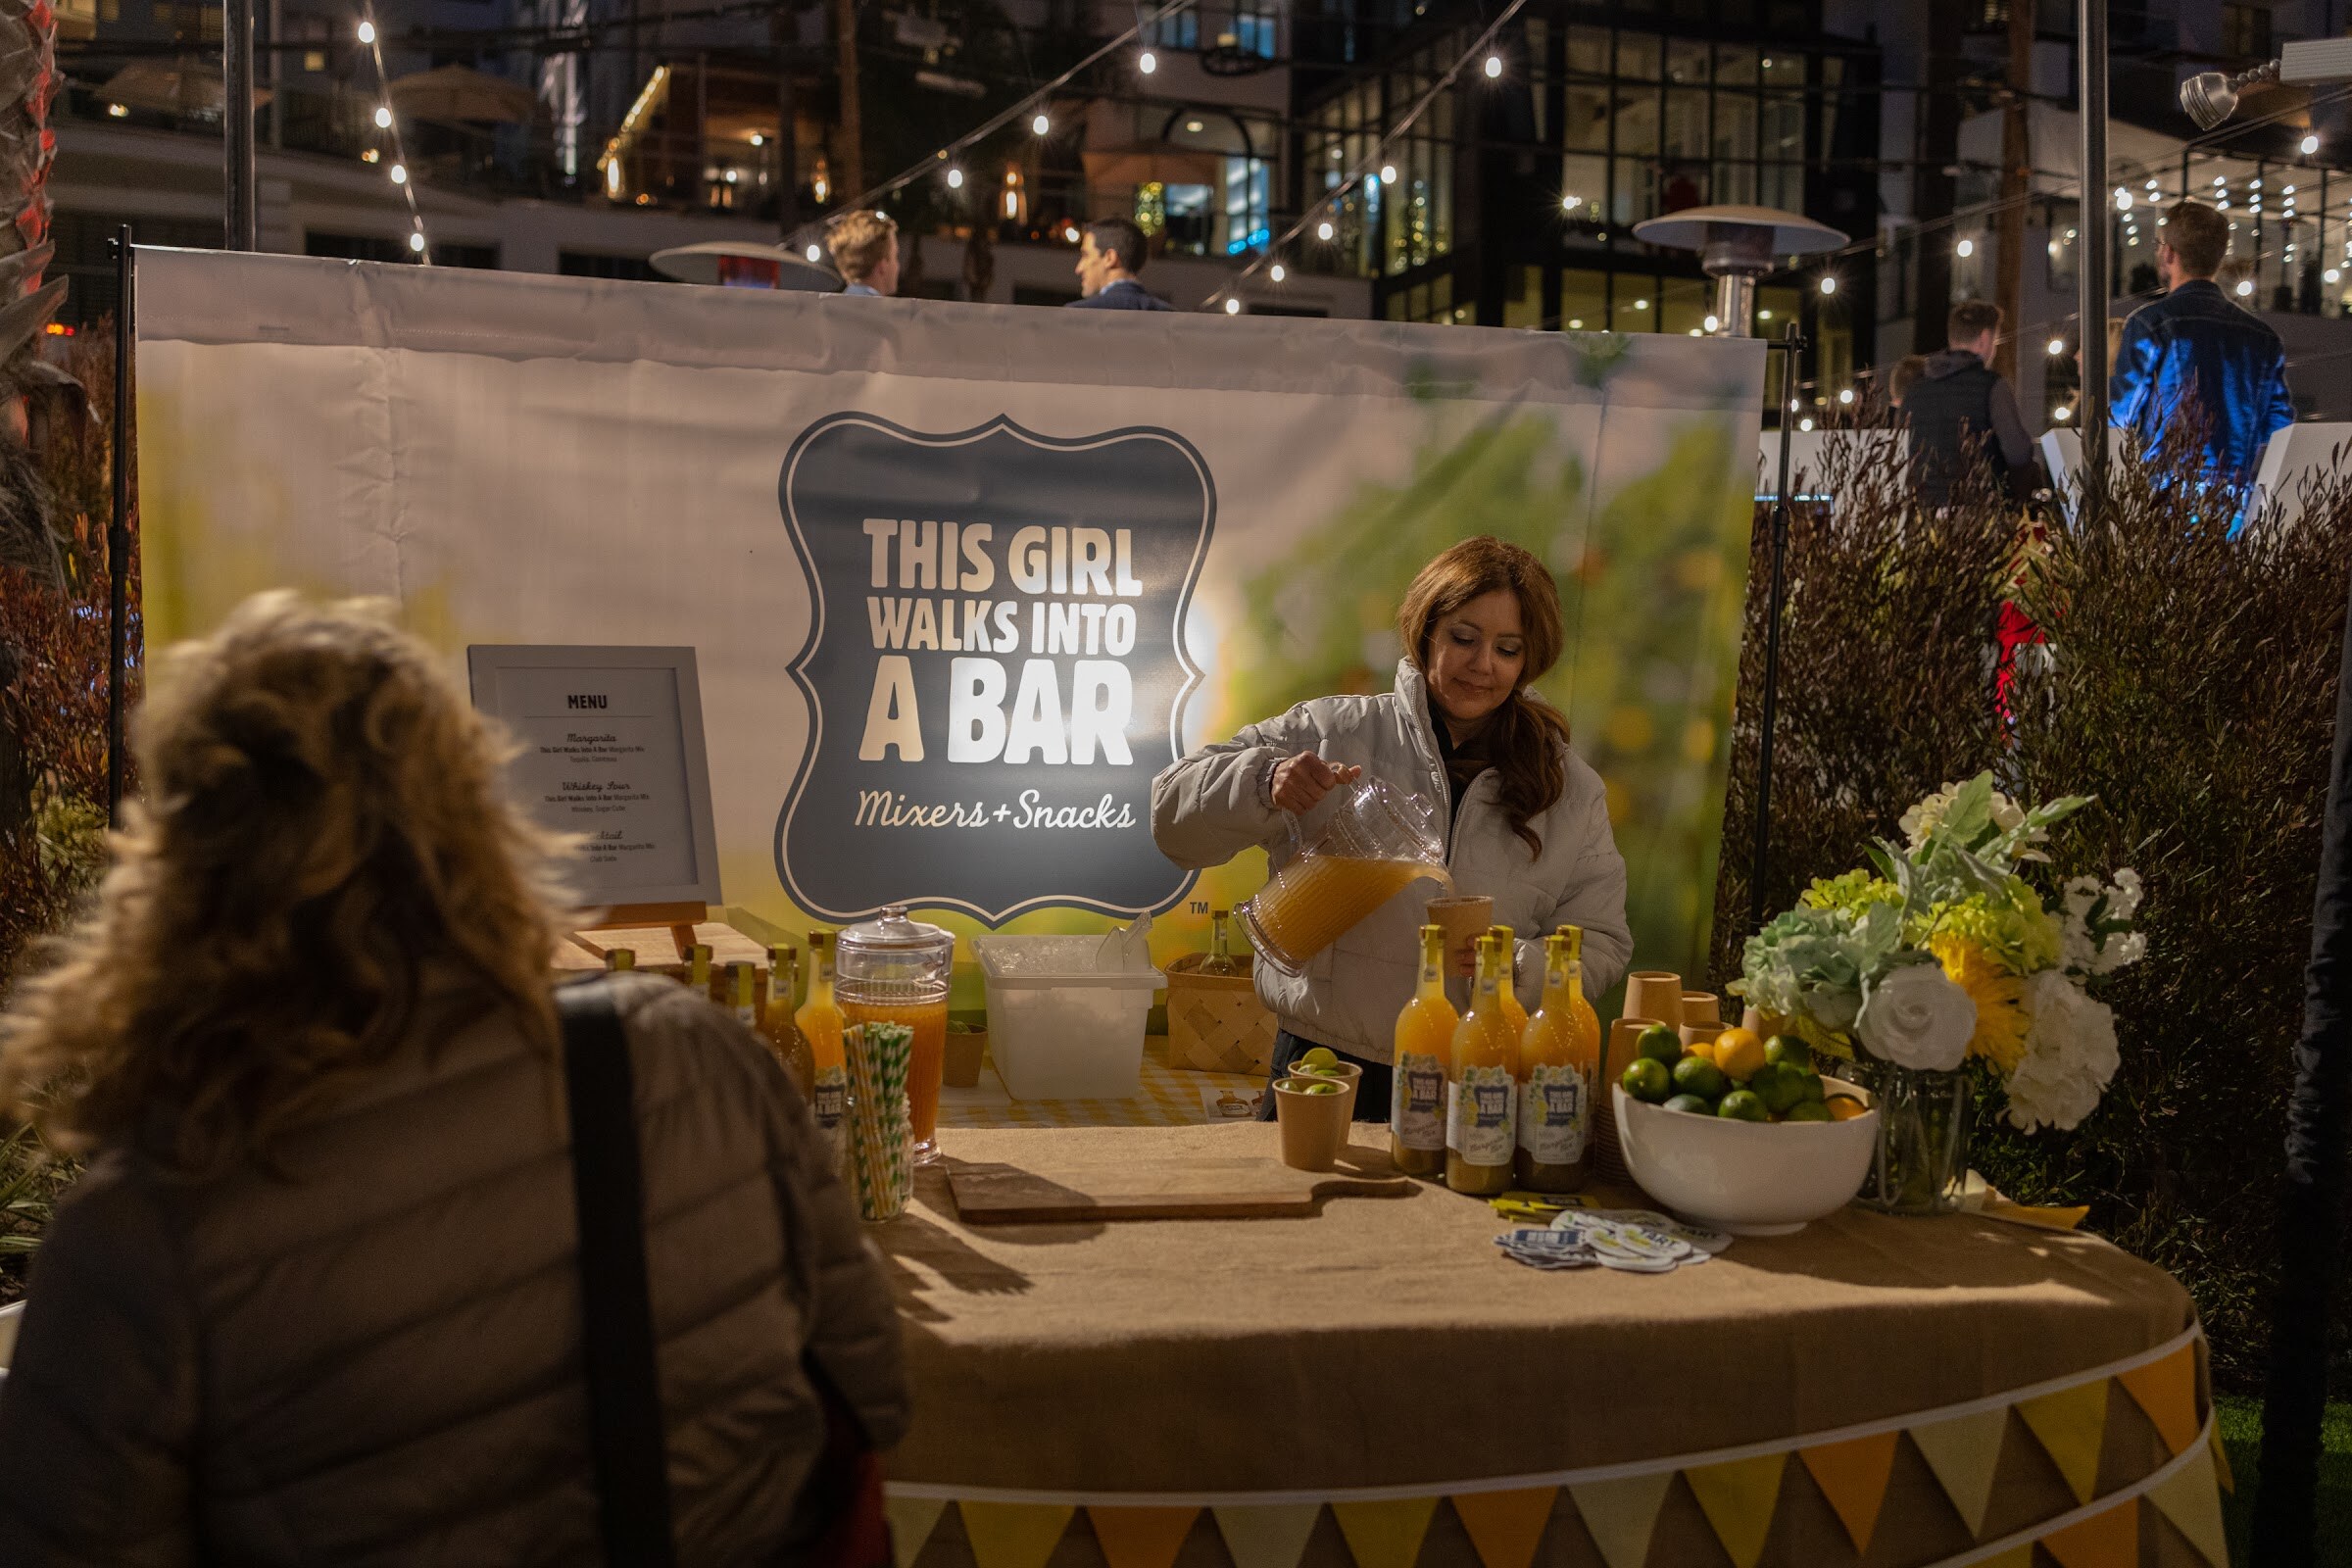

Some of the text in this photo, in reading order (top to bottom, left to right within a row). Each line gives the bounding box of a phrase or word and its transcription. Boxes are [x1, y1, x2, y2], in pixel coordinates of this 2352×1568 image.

[862, 518, 1143, 597] THIS GIRL
[866, 596, 1137, 657] WALKS INTO
[567, 695, 608, 710] MENU
[858, 655, 1134, 765] A BAR
[566, 733, 617, 745] Margarita
[563, 781, 631, 793] Whiskey Sour
[1189, 902, 1208, 914] TM
